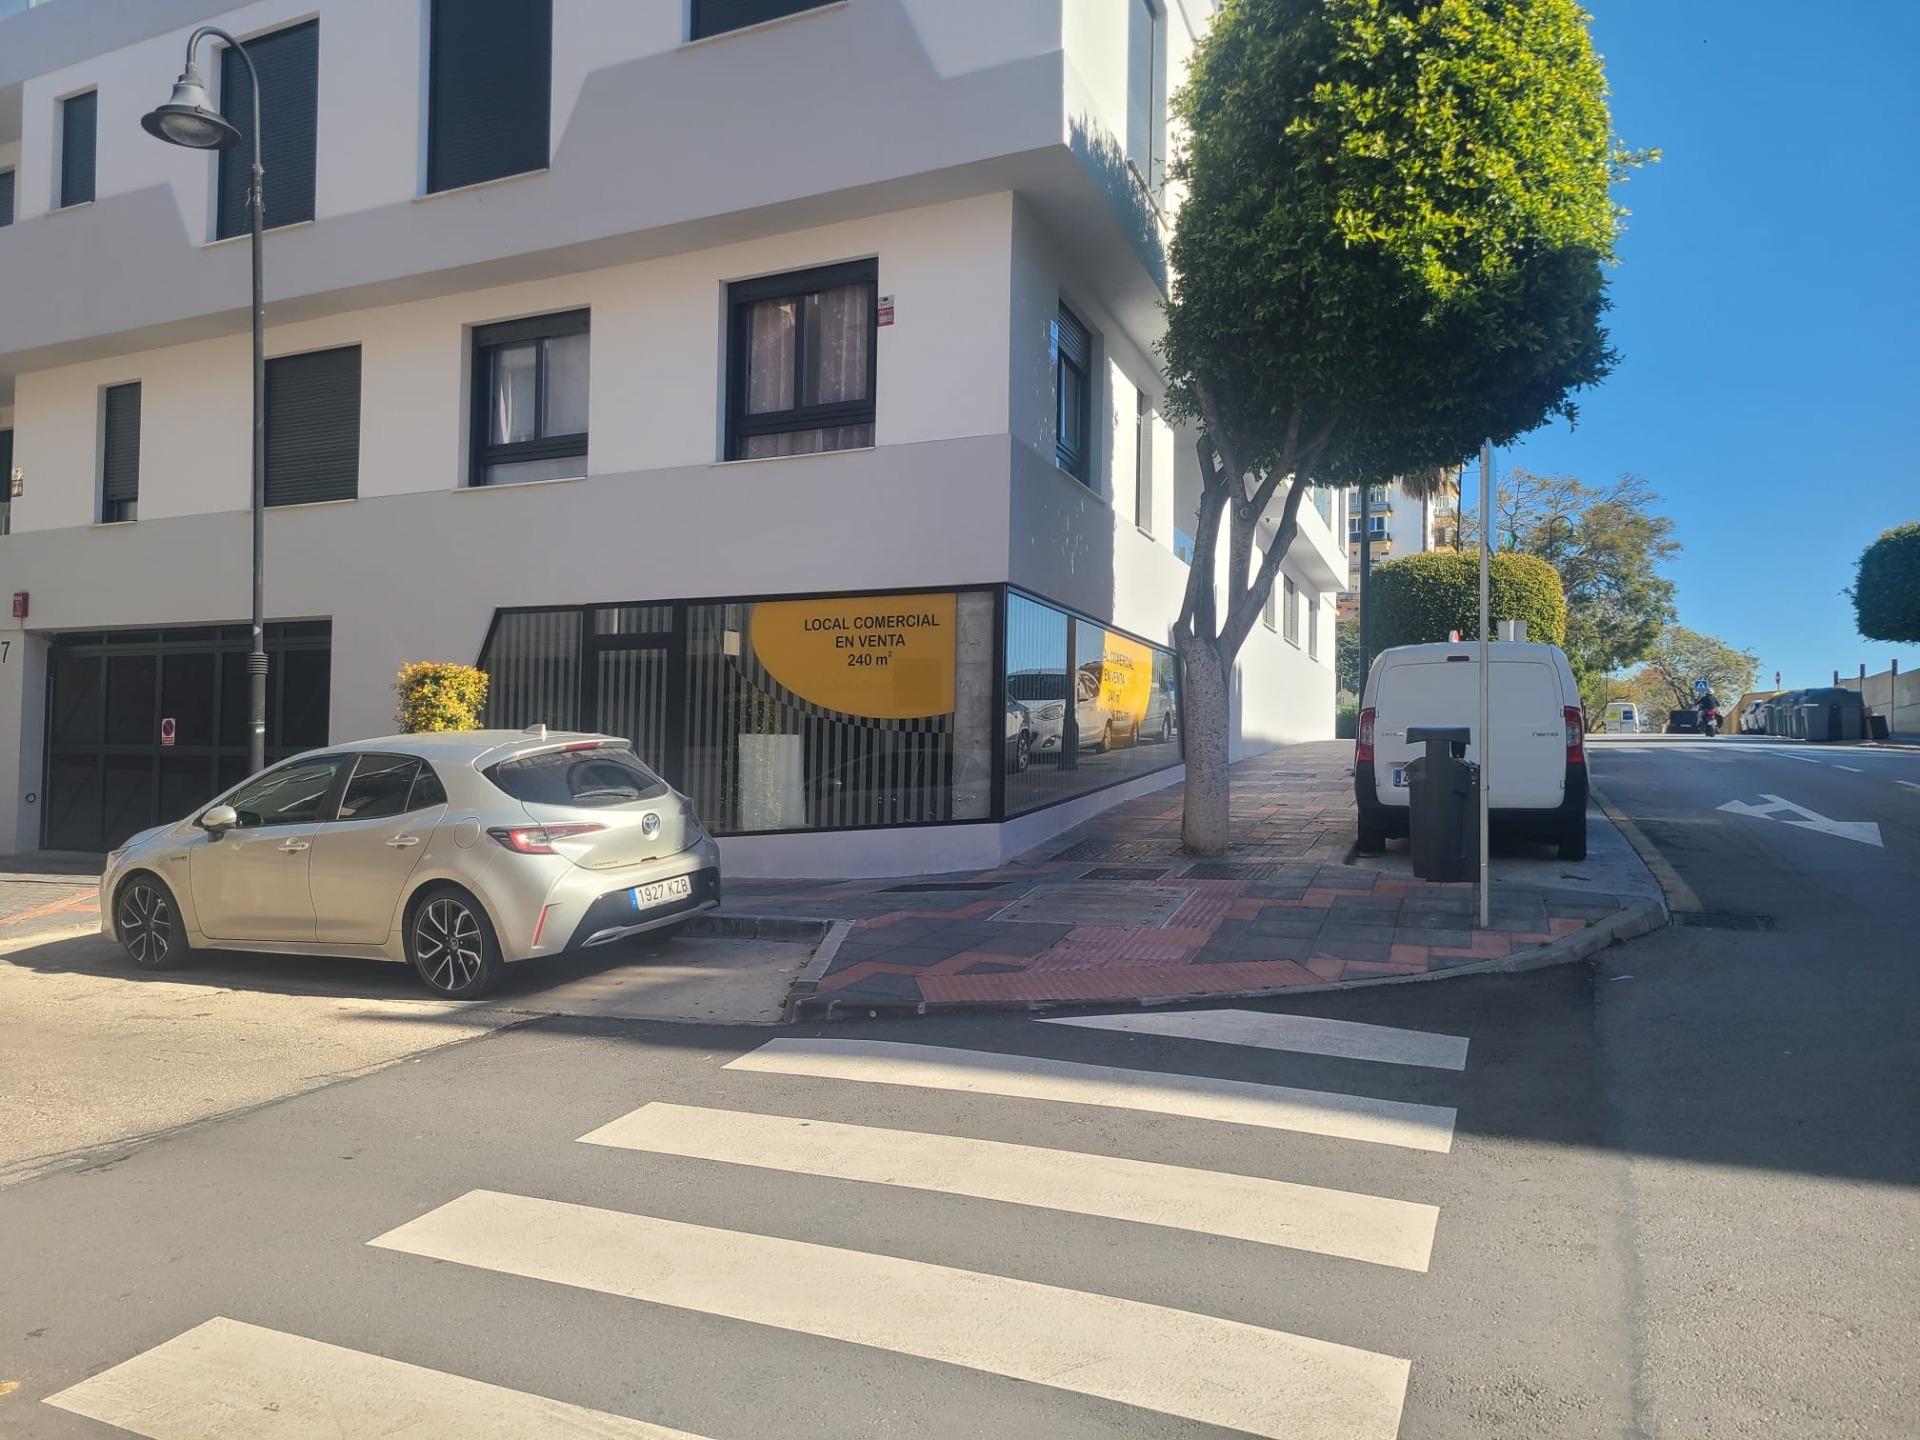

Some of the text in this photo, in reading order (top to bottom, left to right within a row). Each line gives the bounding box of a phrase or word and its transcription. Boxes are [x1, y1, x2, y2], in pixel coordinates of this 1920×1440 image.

[804, 614, 940, 631] LOCAL COMERCIAL
[836, 634, 906, 648] EN VENTA
[847, 654, 872, 667] 240
[639, 879, 688, 903] 1927 KZB
